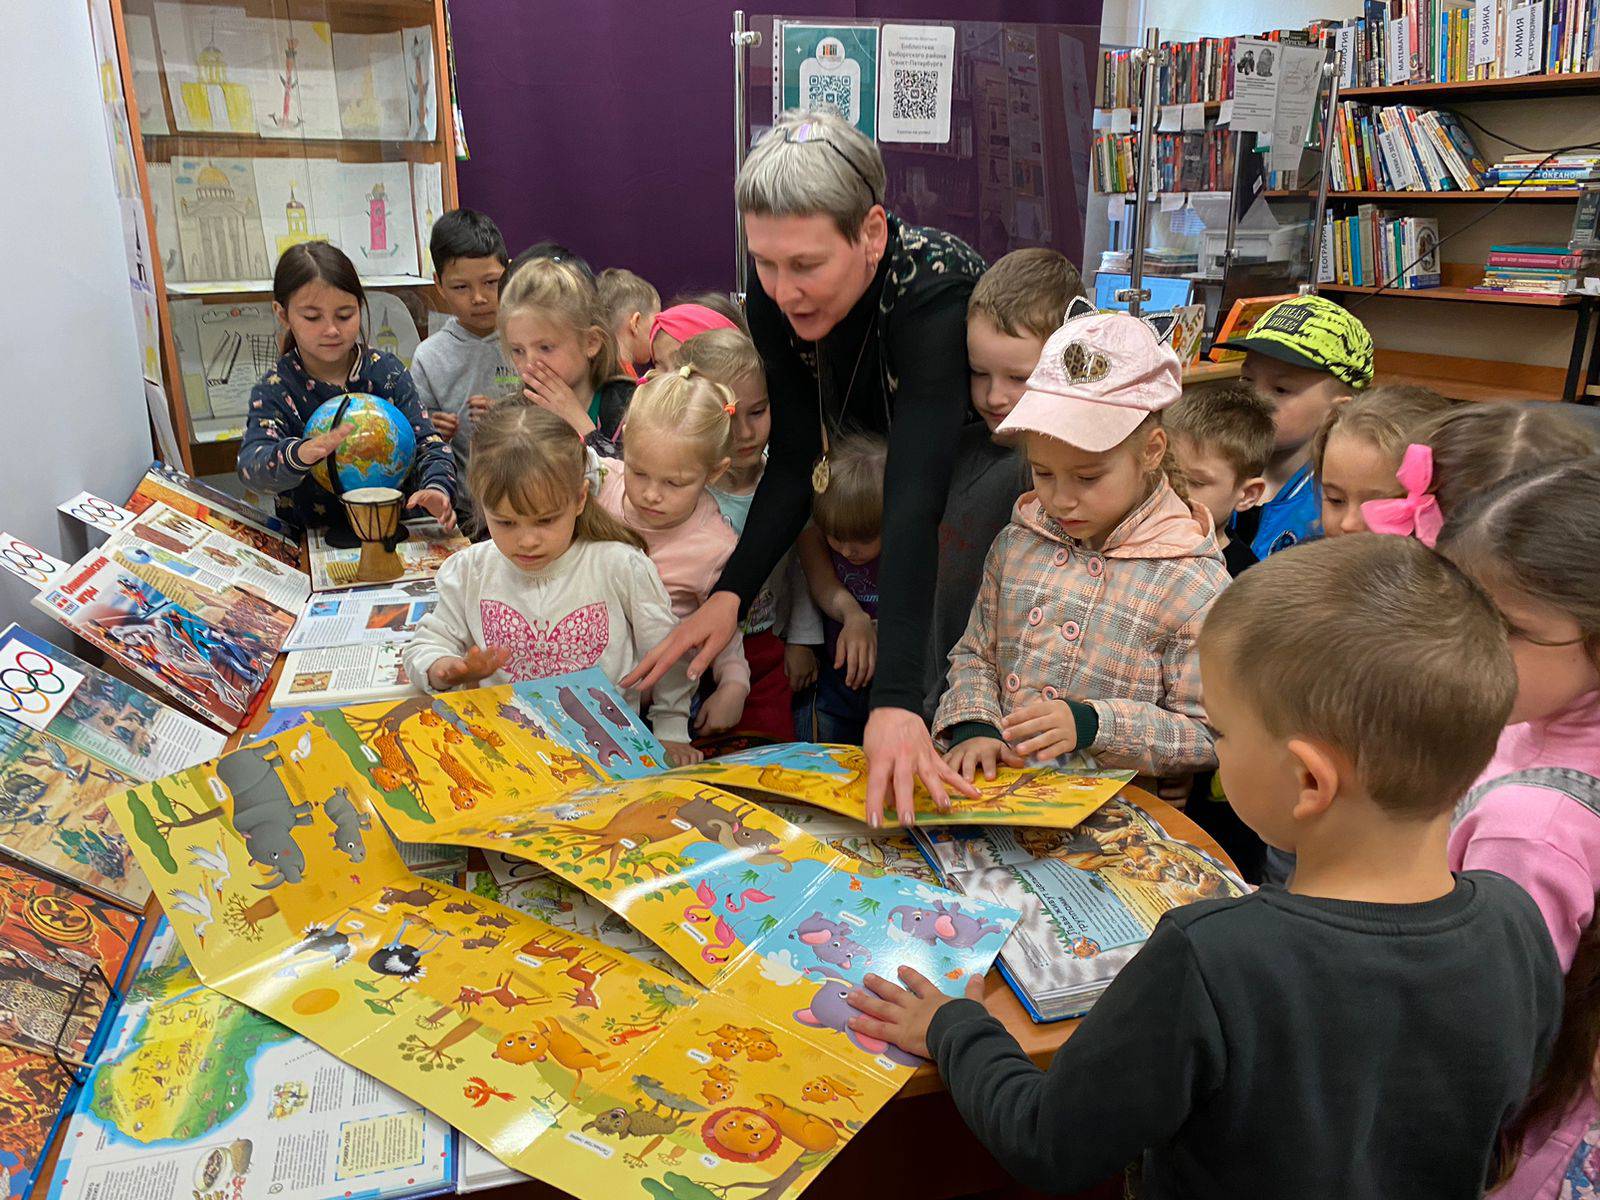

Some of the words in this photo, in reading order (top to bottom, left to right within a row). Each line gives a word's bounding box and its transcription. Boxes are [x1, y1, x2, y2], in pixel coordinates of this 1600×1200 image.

[1481, 5, 1490, 46] ФИЗИКА
[1514, 17, 1524, 58] ХИМИЯ
[1277, 305, 1308, 320] BREAK
[1269, 316, 1299, 332] RULES
[1022, 869, 1045, 892] целыми
[1043, 893, 1062, 915] живут
[1058, 896, 1088, 933] группами
[1061, 914, 1078, 936] Львы
